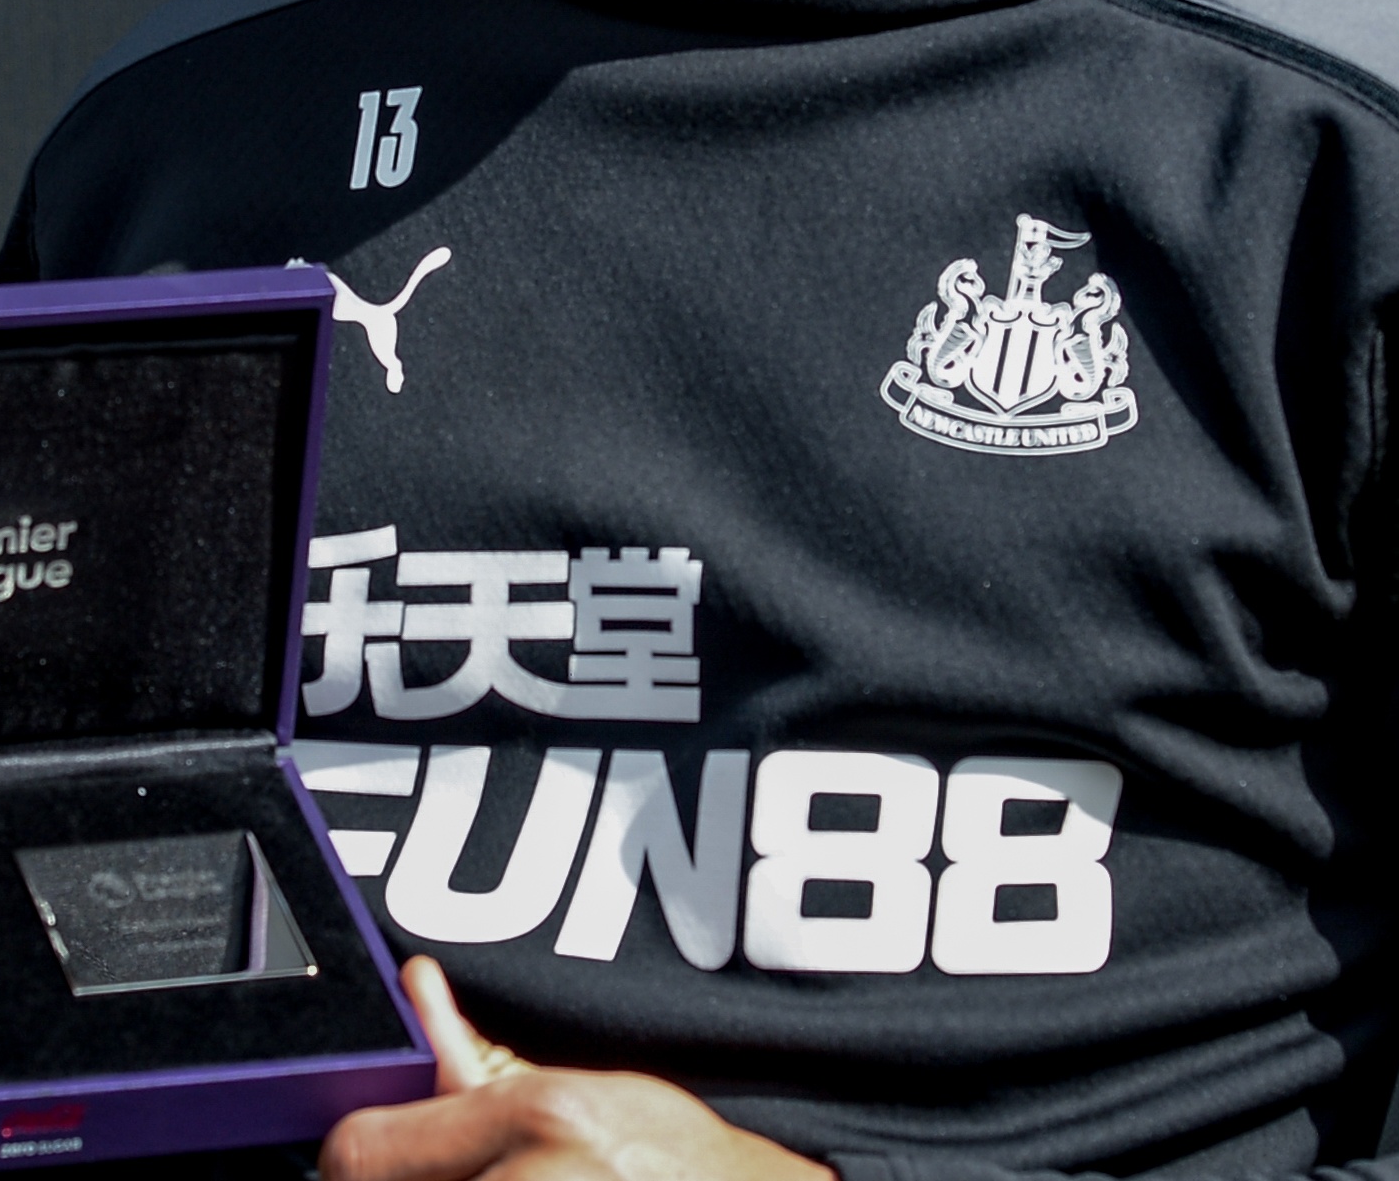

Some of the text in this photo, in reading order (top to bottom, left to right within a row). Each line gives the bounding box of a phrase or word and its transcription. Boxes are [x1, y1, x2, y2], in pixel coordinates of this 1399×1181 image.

[349, 85, 423, 190] 13
[909, 405, 1099, 448] NEWCASTLE UNITED
